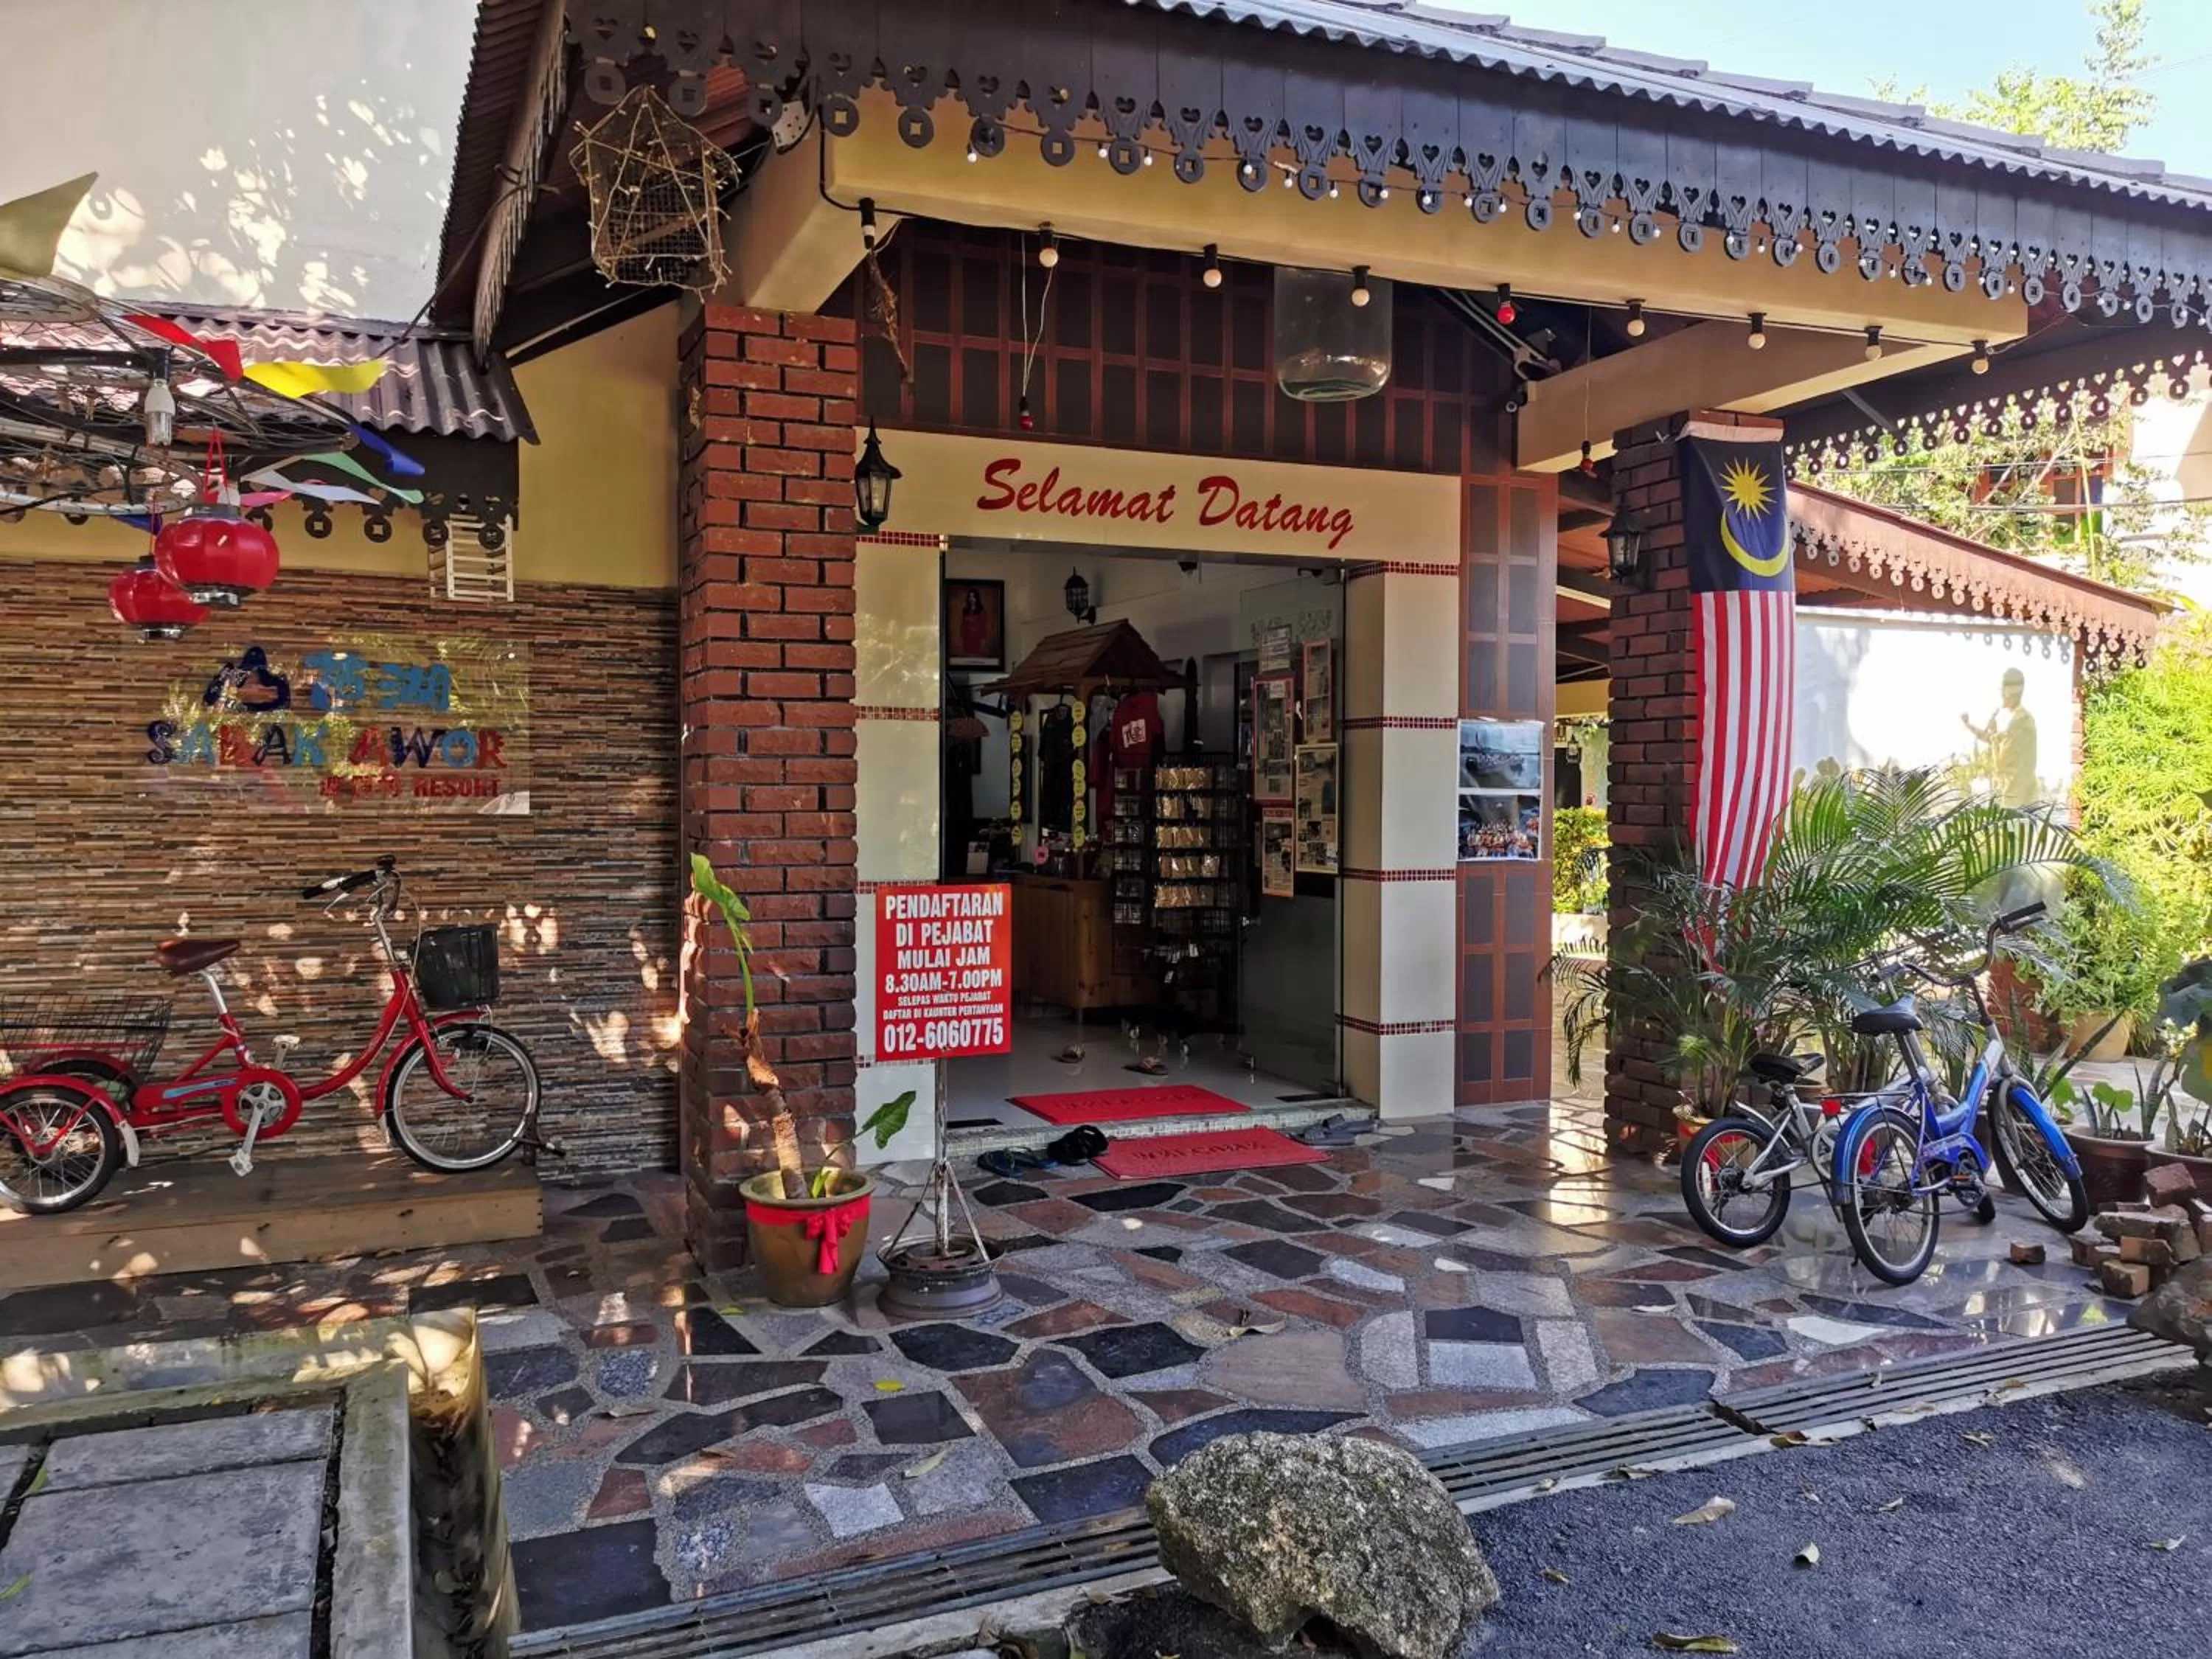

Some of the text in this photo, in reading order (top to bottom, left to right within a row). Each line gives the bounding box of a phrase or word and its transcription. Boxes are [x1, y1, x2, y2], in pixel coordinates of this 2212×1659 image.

[977, 458, 1354, 549] Selamat Datang
[349, 724, 507, 768] AWOR
[413, 777, 502, 798] RESORT
[886, 891, 1004, 919] PENDAFTARAN
[897, 919, 993, 947] DI PEJABAT
[897, 946, 990, 969] MULAI JAM
[885, 968, 1003, 993] 8.30AM-7.00PM
[897, 991, 992, 1006] SELEPAS WAKTU PEJABAT
[883, 1003, 1004, 1021] DAFTAR DI KAUNTER PERTANYAAN
[884, 1018, 1004, 1053] 012-6060775
